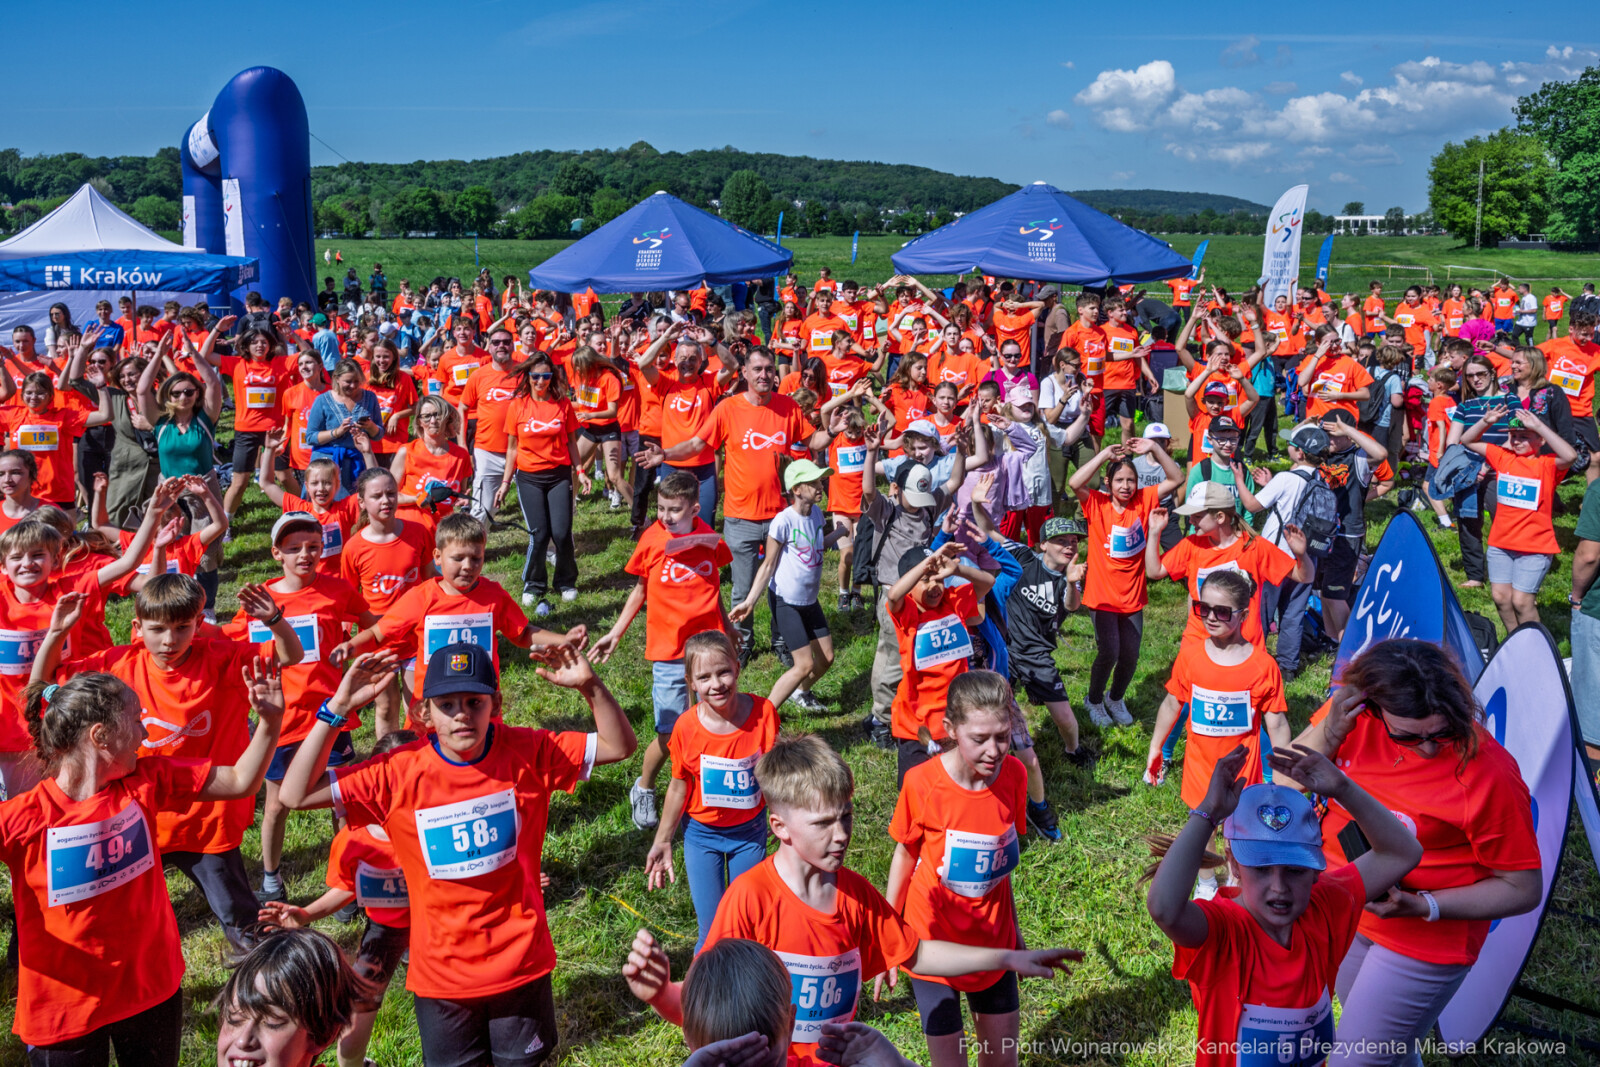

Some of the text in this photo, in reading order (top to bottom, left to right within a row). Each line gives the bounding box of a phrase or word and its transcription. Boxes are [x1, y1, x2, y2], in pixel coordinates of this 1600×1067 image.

[80, 266, 162, 286] Kraków
[1507, 482, 1526, 496] 524
[1020, 586, 1058, 614] adidas
[447, 628, 478, 645] 493
[930, 628, 957, 648] 523
[18, 640, 41, 658] 48
[1204, 702, 1233, 720] 522
[723, 771, 756, 790] 492
[452, 818, 498, 852] 583
[86, 834, 133, 870] 494
[975, 848, 1008, 874] 585
[383, 879, 408, 894] 49
[798, 976, 842, 1010] 586
